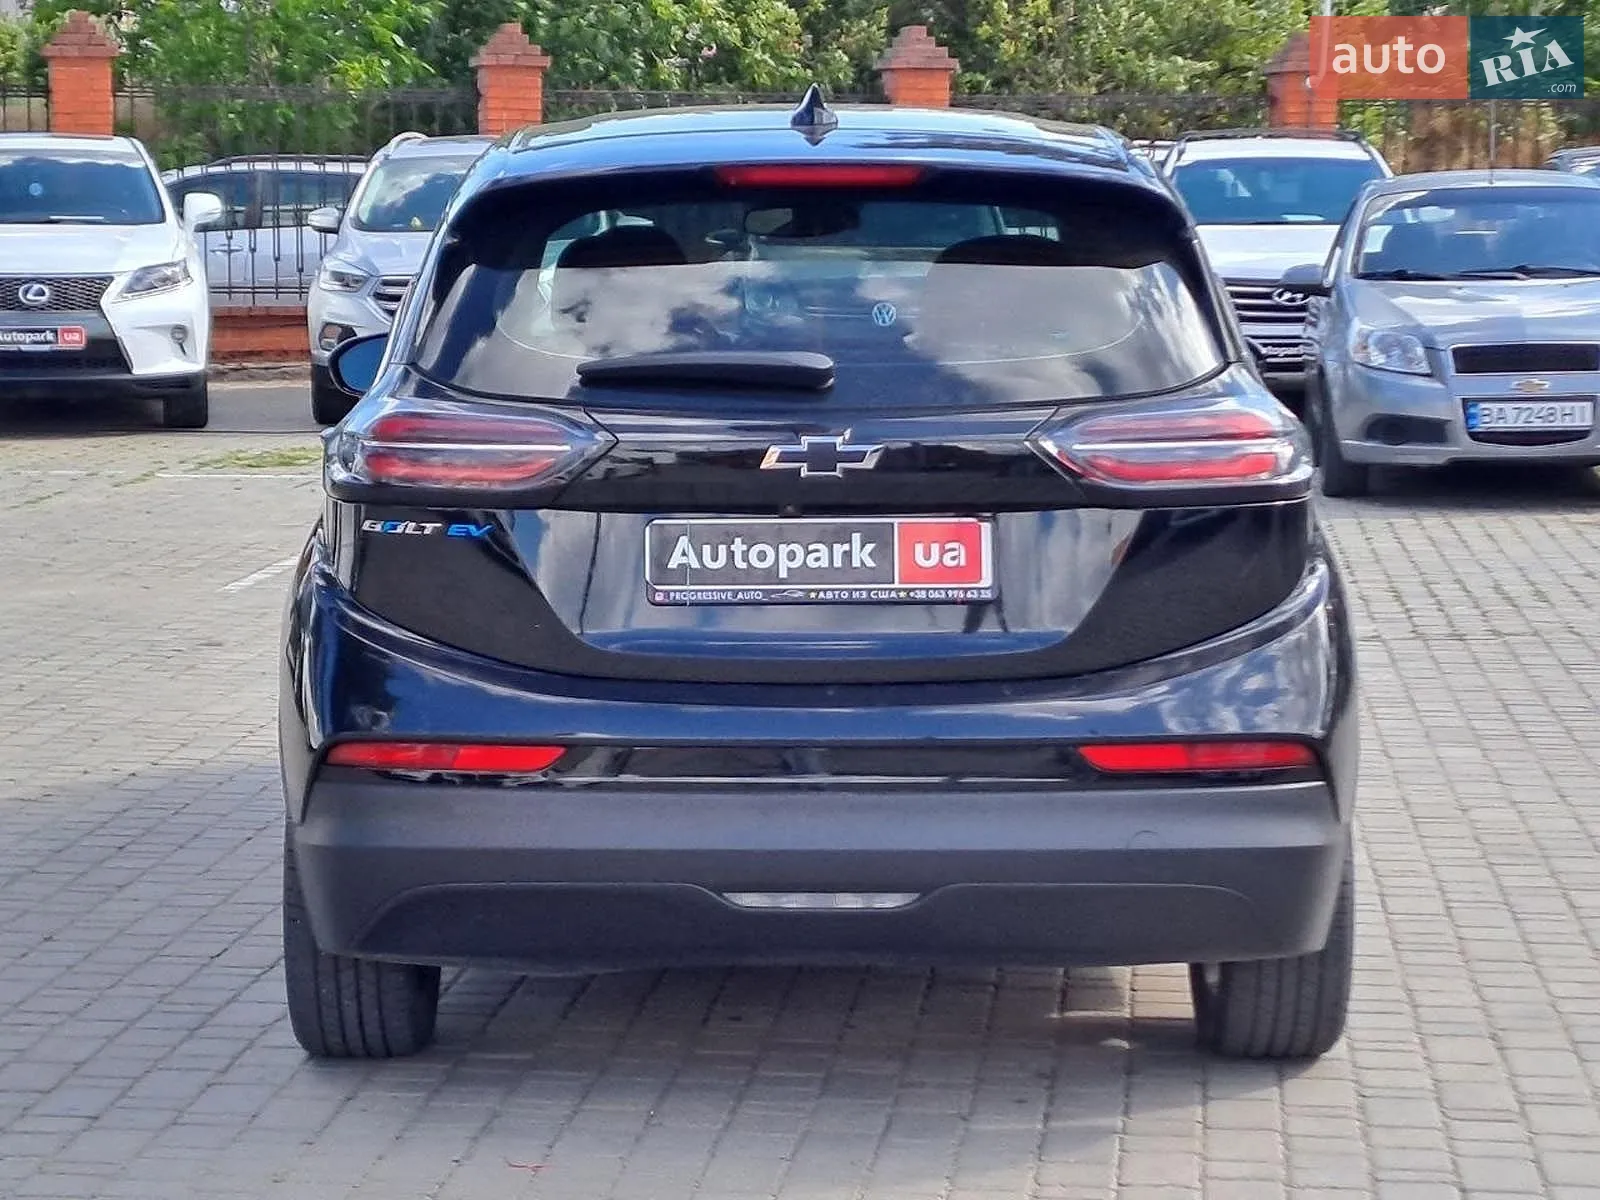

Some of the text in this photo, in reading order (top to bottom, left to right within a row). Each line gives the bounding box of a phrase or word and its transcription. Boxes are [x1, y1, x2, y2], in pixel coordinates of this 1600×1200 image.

[362, 519, 494, 536] BOLT EV
[667, 533, 966, 578] Autopark ua
